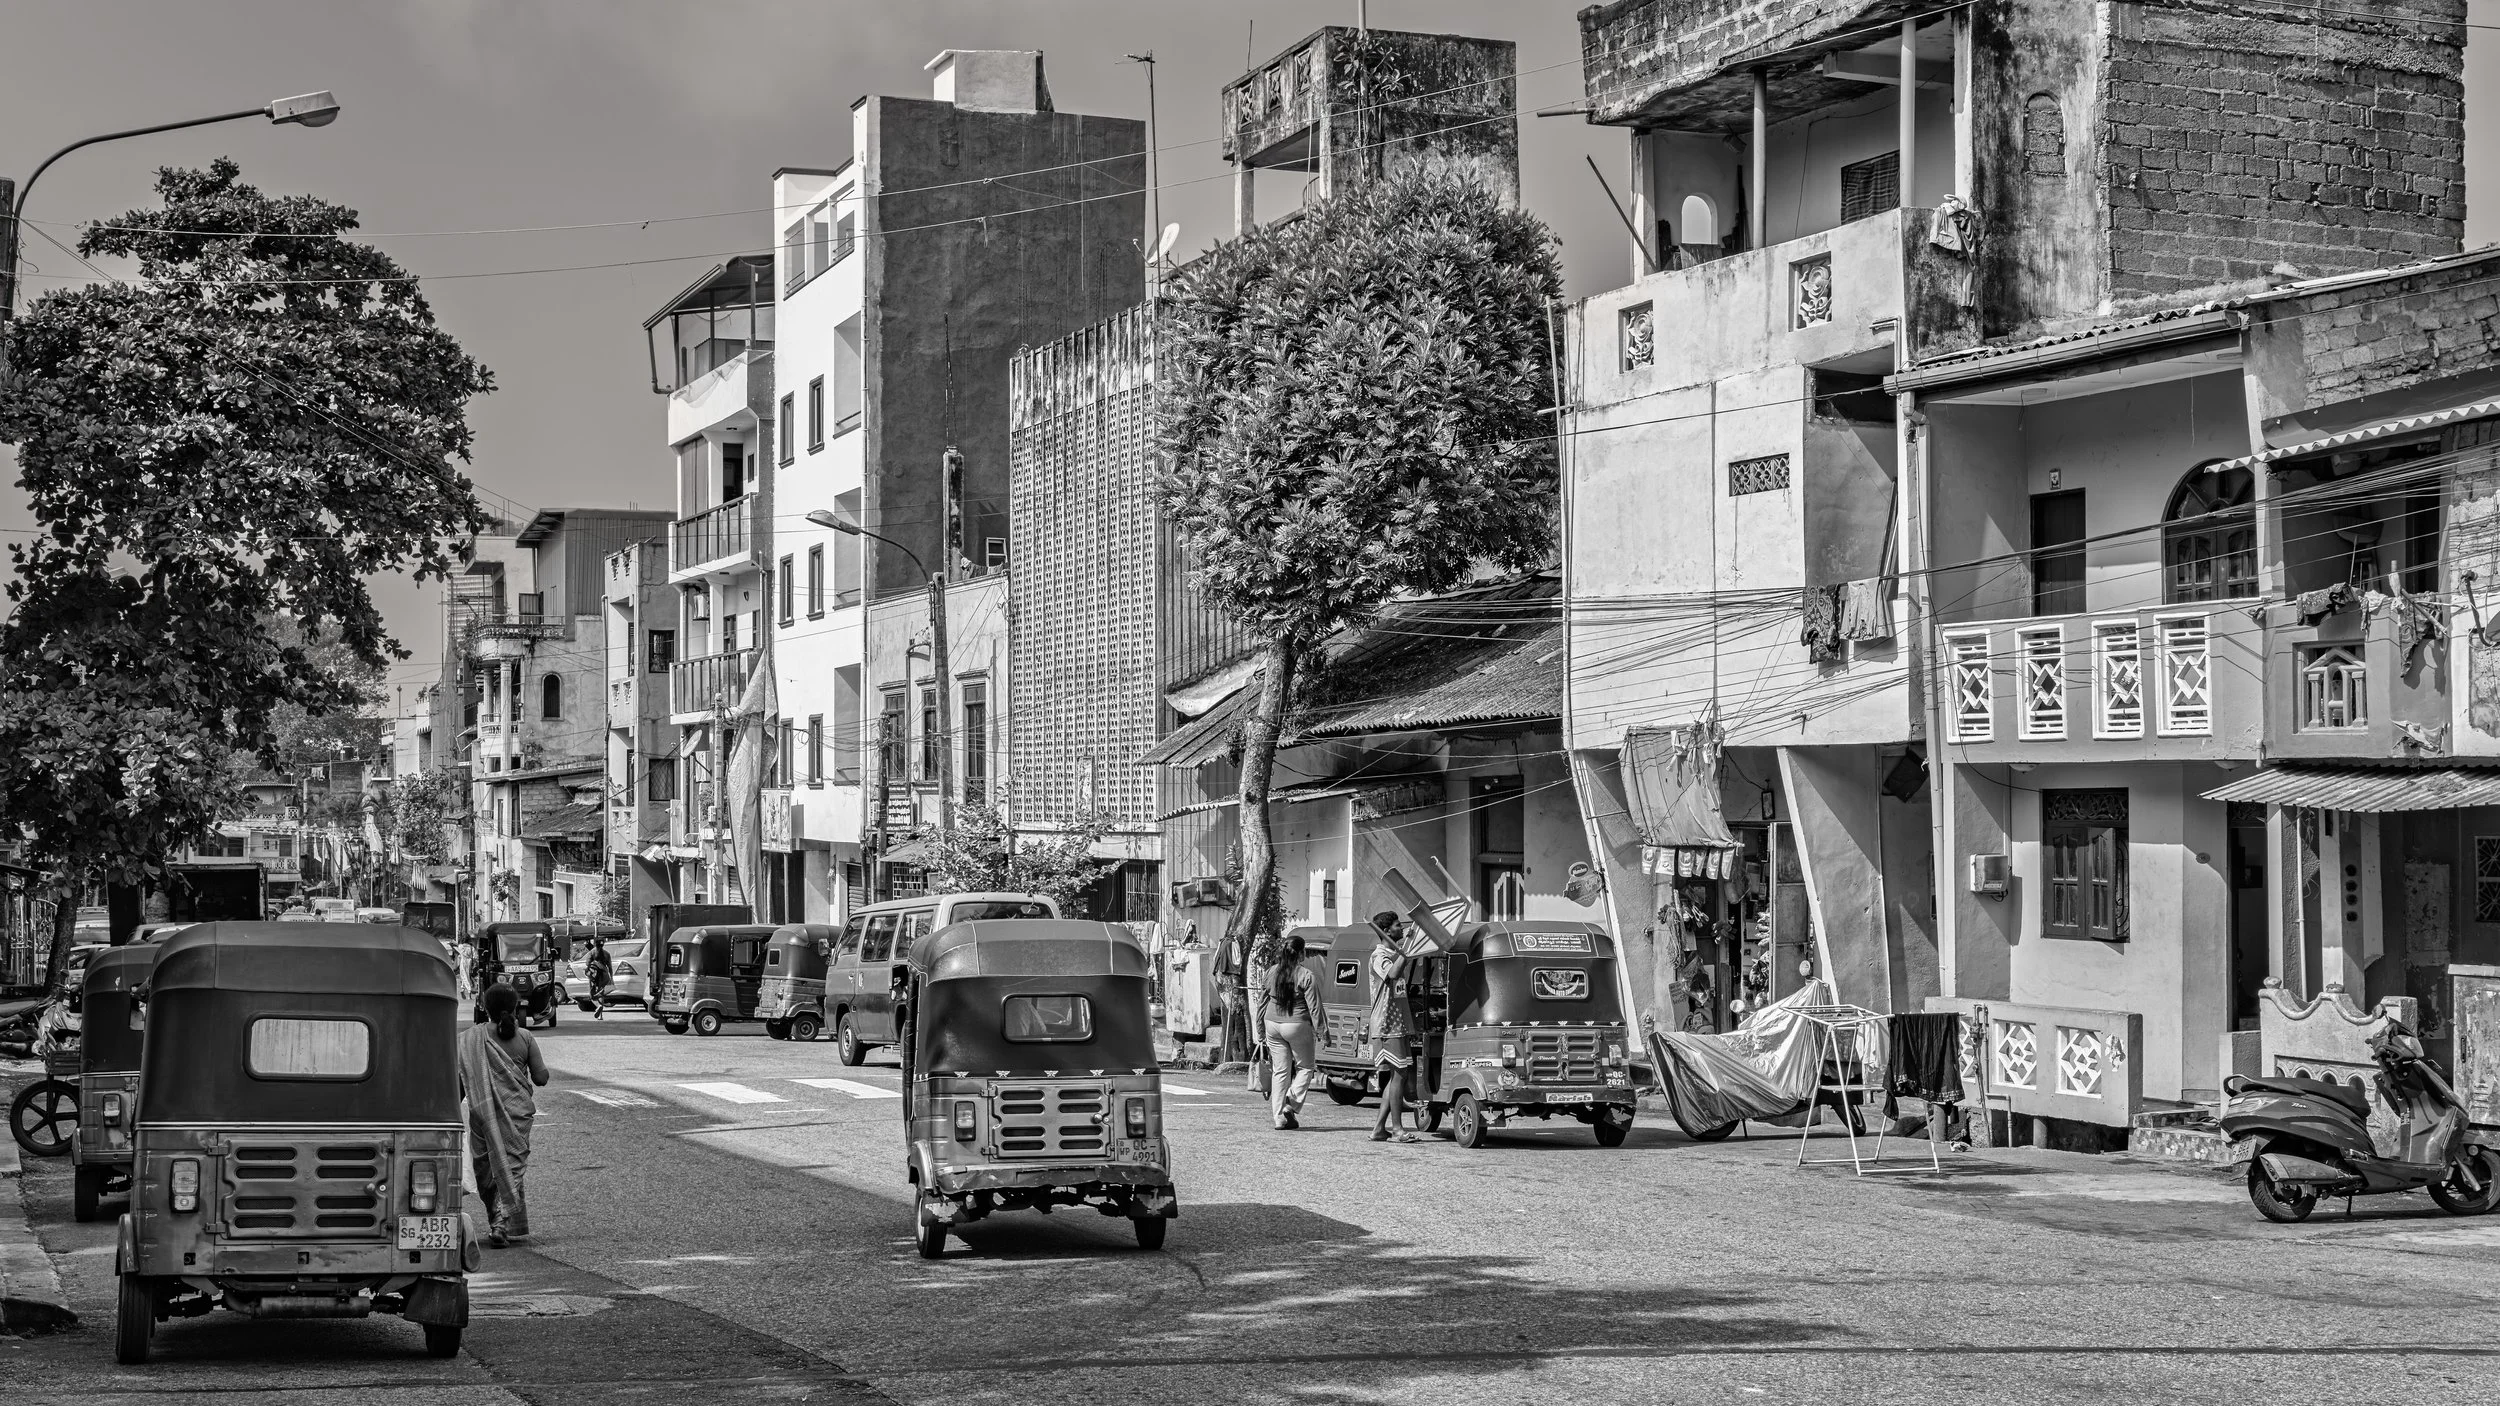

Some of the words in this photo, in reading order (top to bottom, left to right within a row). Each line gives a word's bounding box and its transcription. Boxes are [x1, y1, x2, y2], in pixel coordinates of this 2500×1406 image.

[1132, 1152, 1156, 1162] 4991
[420, 1218, 449, 1232] ABR
[401, 1228, 415, 1238] SG
